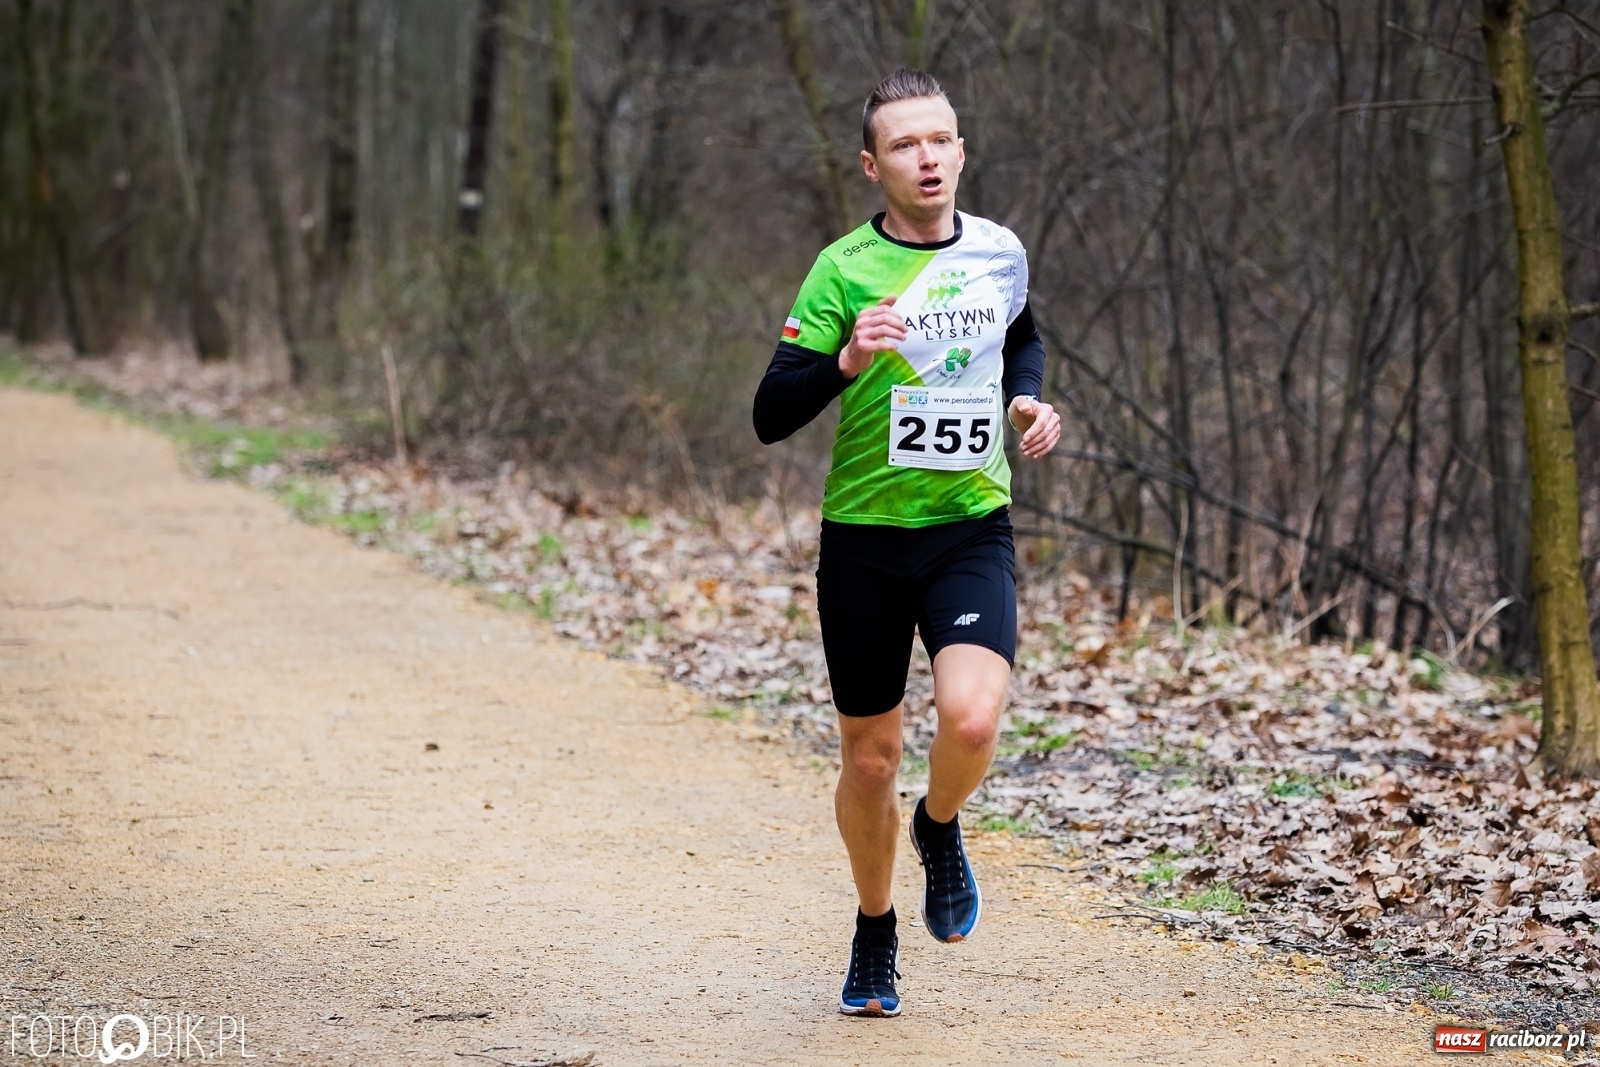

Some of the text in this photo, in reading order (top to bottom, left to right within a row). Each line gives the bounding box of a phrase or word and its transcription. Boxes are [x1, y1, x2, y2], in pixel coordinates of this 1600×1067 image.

[904, 307, 996, 332] AKTYWNI
[925, 325, 981, 341] LYSKI
[896, 416, 991, 454] 255
